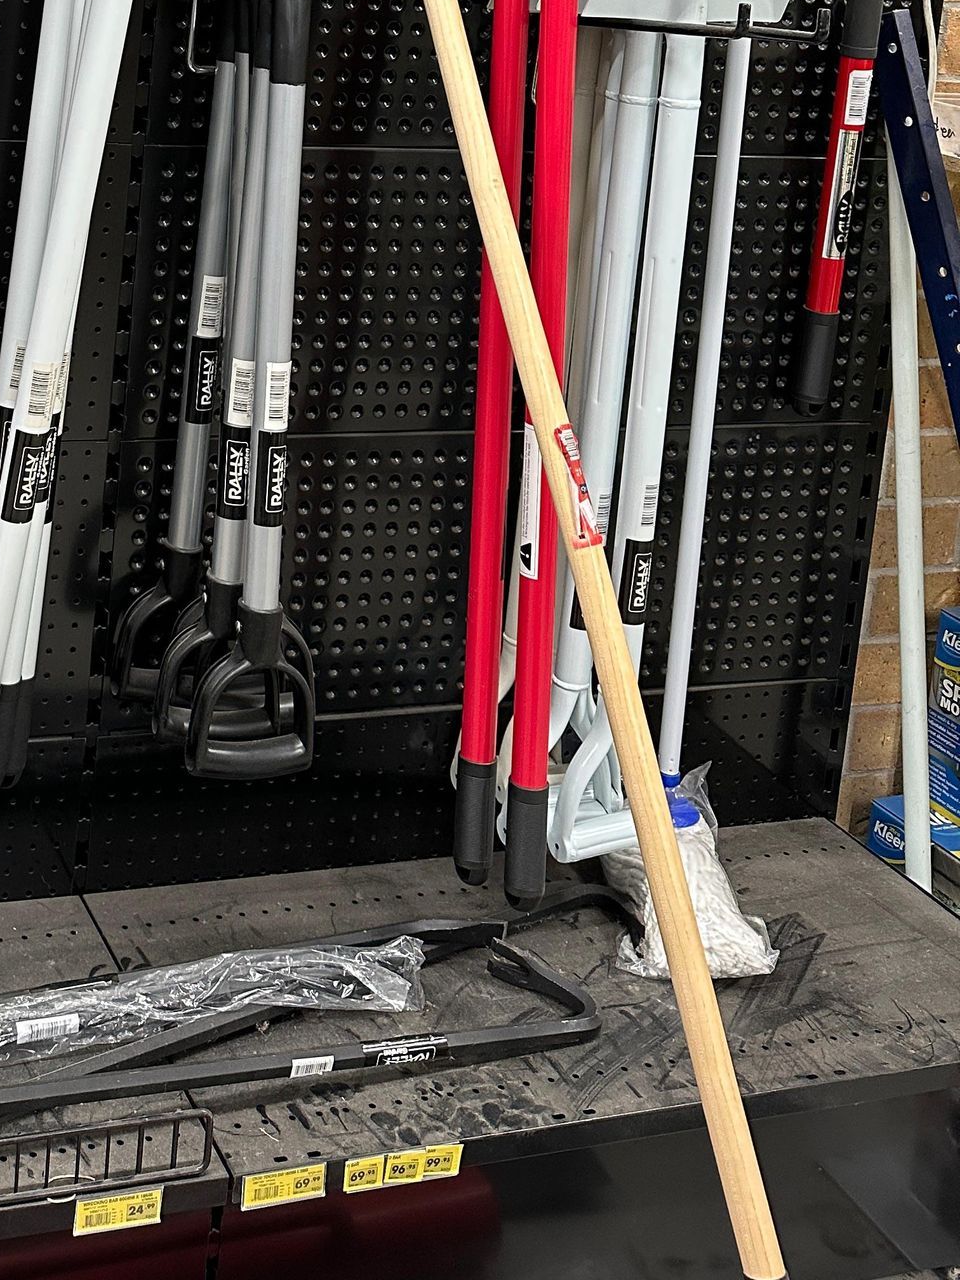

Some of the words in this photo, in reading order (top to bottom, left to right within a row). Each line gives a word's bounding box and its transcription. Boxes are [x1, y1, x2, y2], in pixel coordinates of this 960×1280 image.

[200, 356, 216, 406] RALLY
[19, 451, 40, 505] RALLY
[228, 446, 244, 500] RALLY
[270, 452, 285, 507] RALLY
[634, 558, 649, 608] RALLY
[391, 1164, 416, 1174] 96.95
[426, 1157, 450, 1168] 99.95
[296, 1176, 321, 1189] 69.99
[350, 1170, 376, 1182] 69.95
[83, 1199, 108, 1208] WRECKING
[128, 1203, 156, 1216] 24.99
